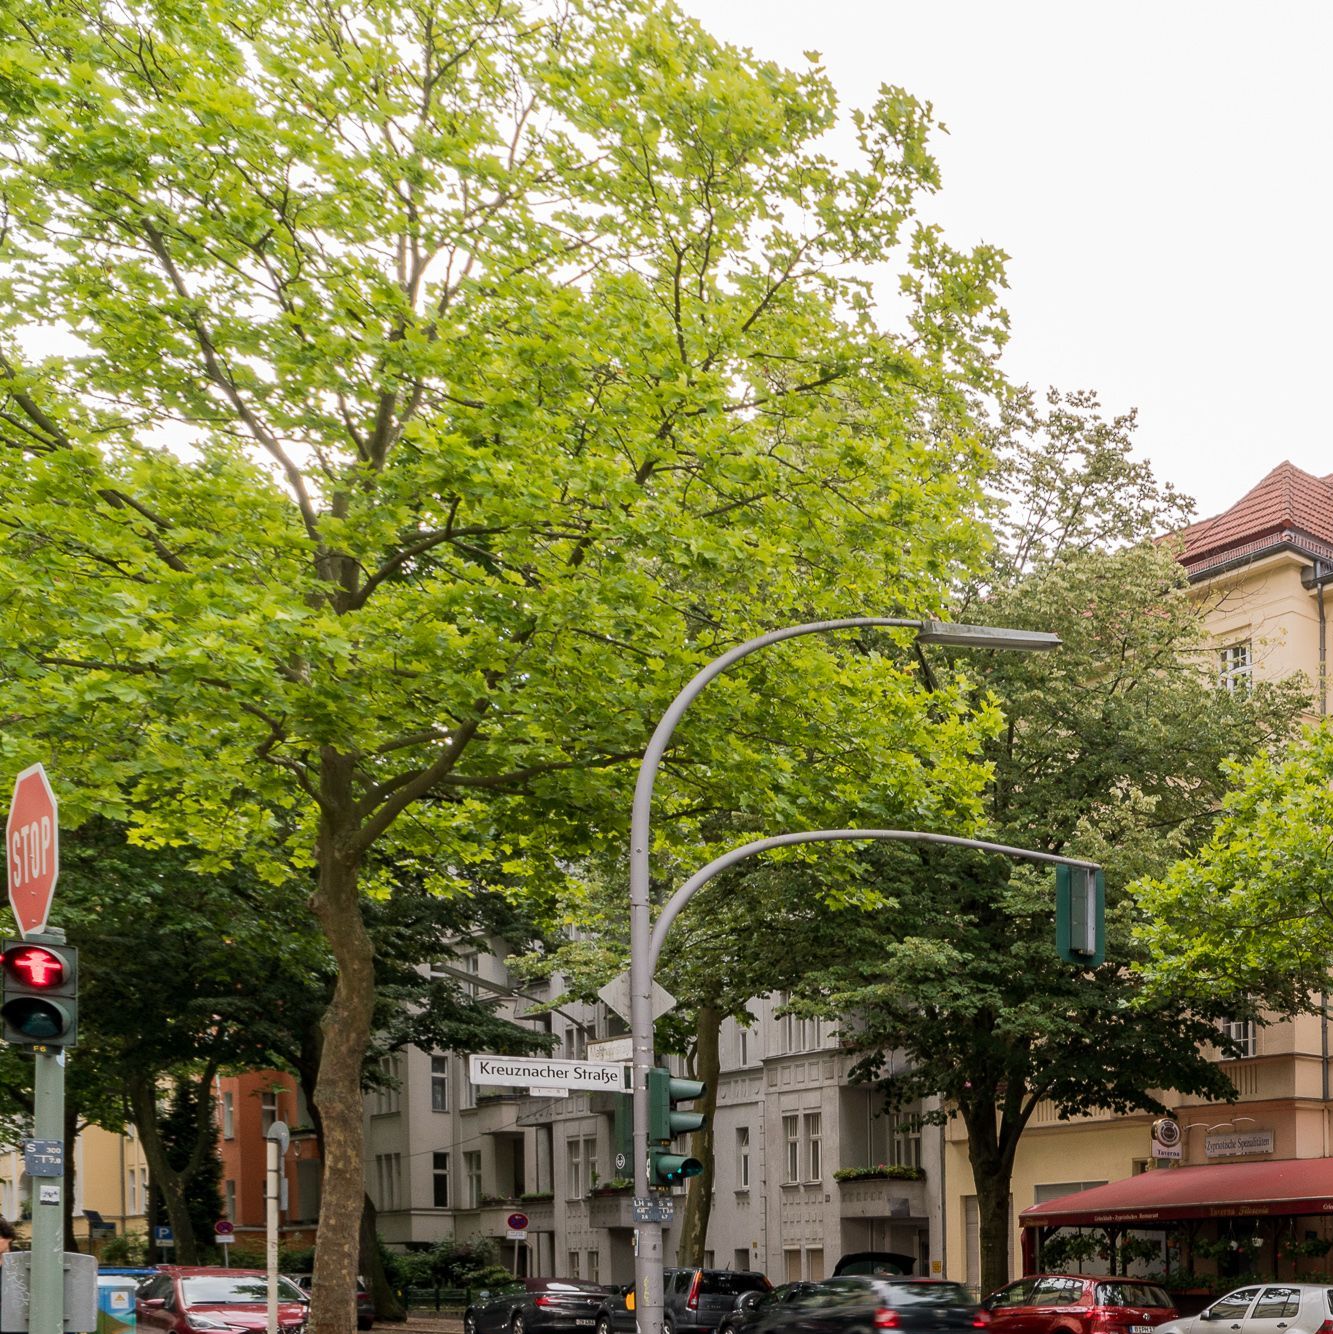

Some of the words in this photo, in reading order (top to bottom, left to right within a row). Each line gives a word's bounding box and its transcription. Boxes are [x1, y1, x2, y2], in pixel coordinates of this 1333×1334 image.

[12, 815, 51, 888] STOP
[480, 1061, 569, 1079] Kreuznacher
[573, 1066, 618, 1084] Straße
[26, 1143, 37, 1153] S
[1157, 1149, 1180, 1157] Taverna
[158, 1228, 170, 1238] P
